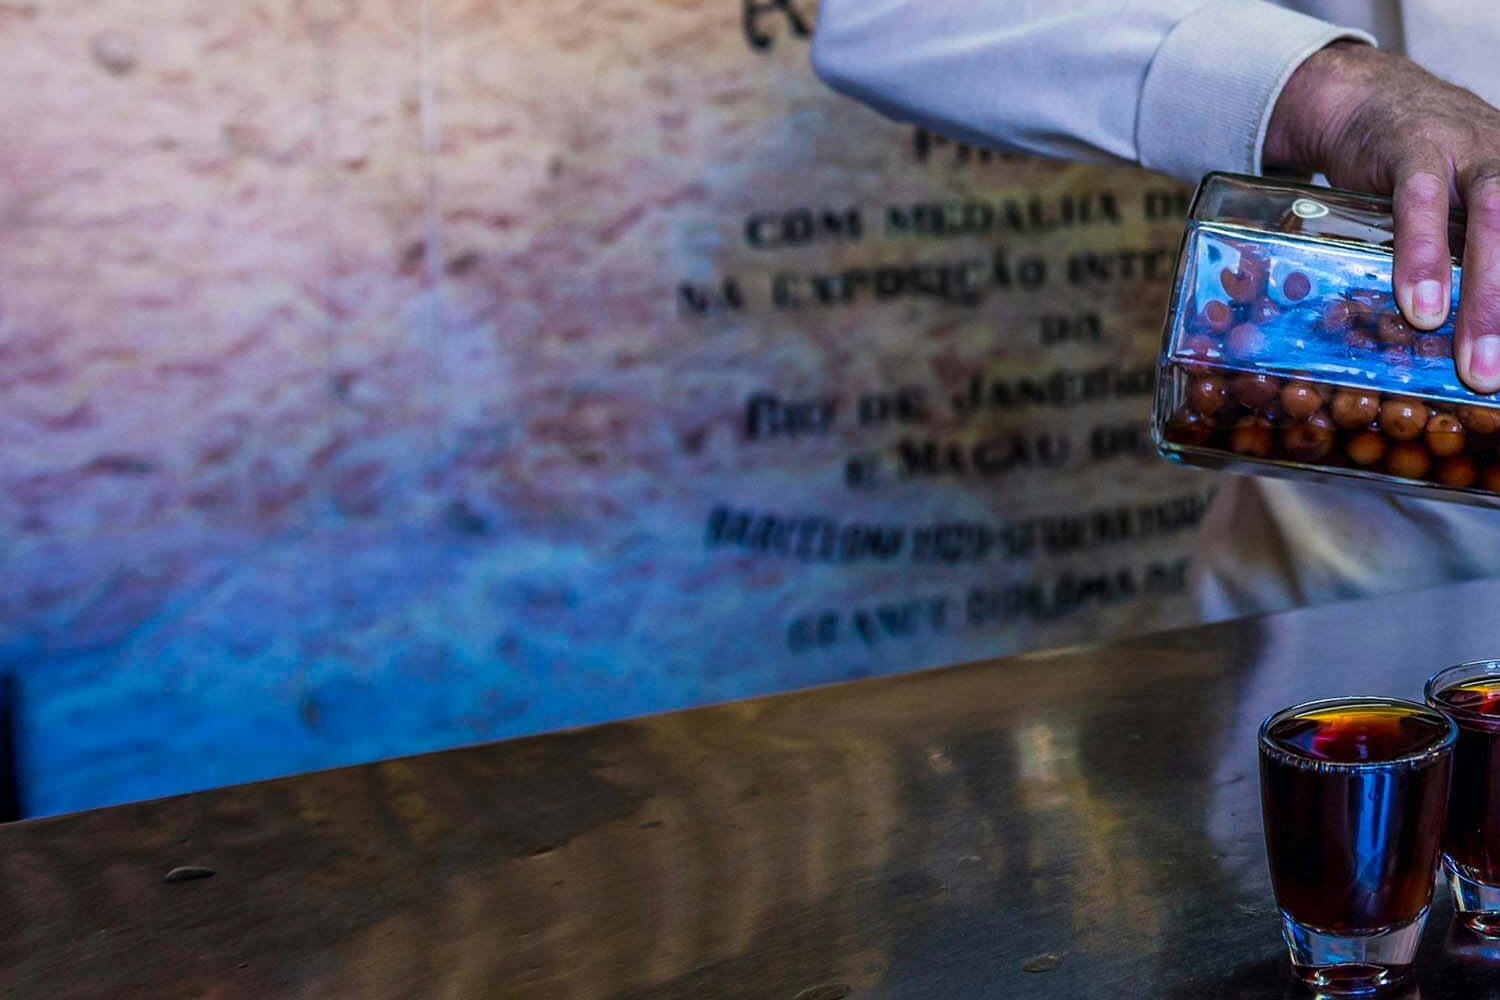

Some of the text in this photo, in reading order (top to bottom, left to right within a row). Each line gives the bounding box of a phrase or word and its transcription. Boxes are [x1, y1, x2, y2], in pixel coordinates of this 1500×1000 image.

[743, 206, 863, 250] COM
[884, 189, 1123, 241] MEDALHA
[677, 277, 746, 315] NA
[772, 247, 1047, 311] EXPOSIÇÃO
[857, 384, 929, 427] DE
